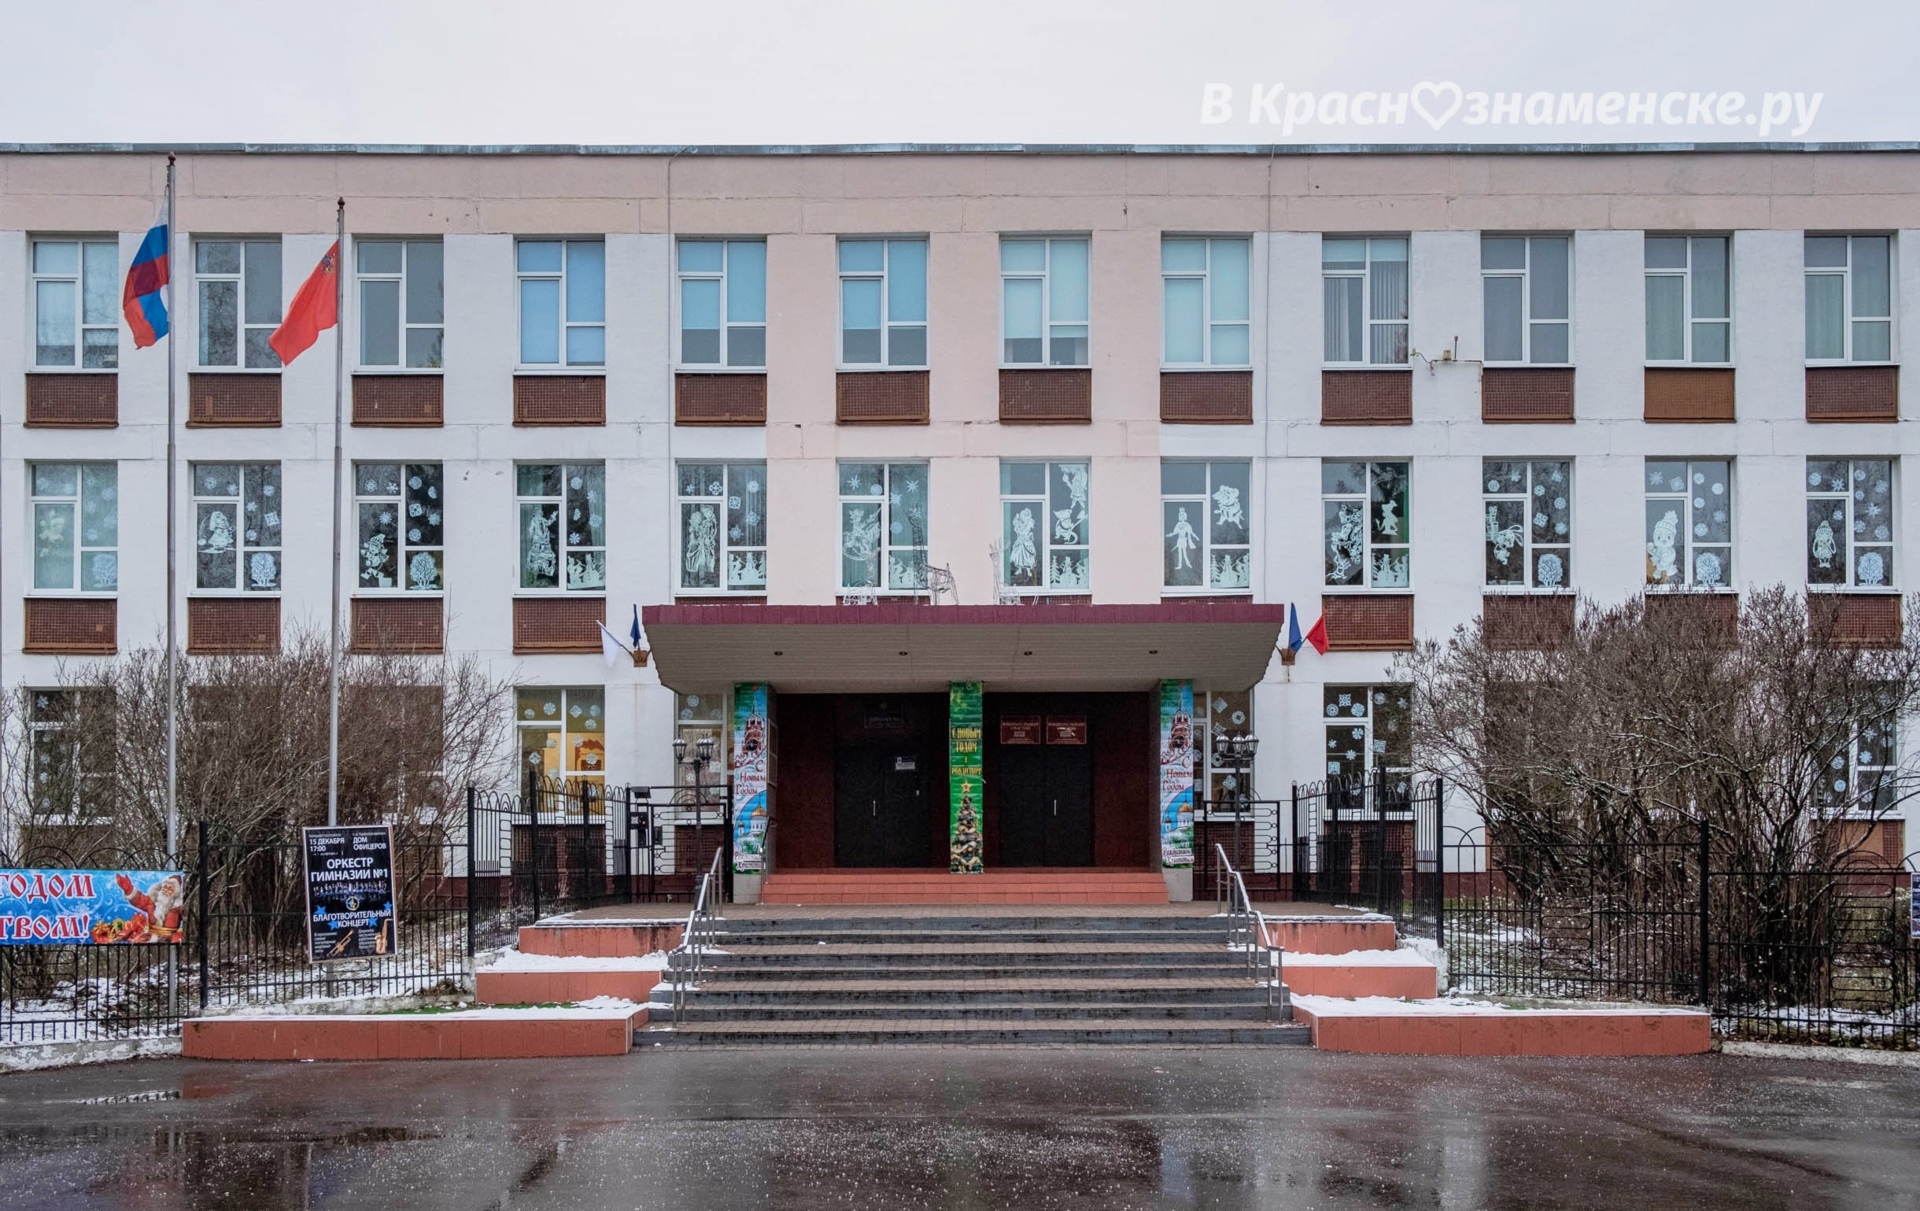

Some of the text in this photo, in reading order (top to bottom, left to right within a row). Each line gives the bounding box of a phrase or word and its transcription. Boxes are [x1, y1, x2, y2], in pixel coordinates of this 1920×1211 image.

[755, 759, 765, 772] С
[1182, 756, 1190, 769] С
[317, 837, 345, 846] ДЕКАБРЯ
[352, 836, 368, 845] ДОМ
[310, 845, 326, 853] 17:00
[353, 842, 387, 851] ОФИЦЕРОВ
[326, 857, 374, 869] ОРКЕСТР
[310, 868, 388, 882] ГИМНАЗИИ №1
[313, 910, 391, 922] БЛАГОТВОРИТЕЛЬНЫЙ
[337, 919, 369, 928] КОНЦЕРТ
